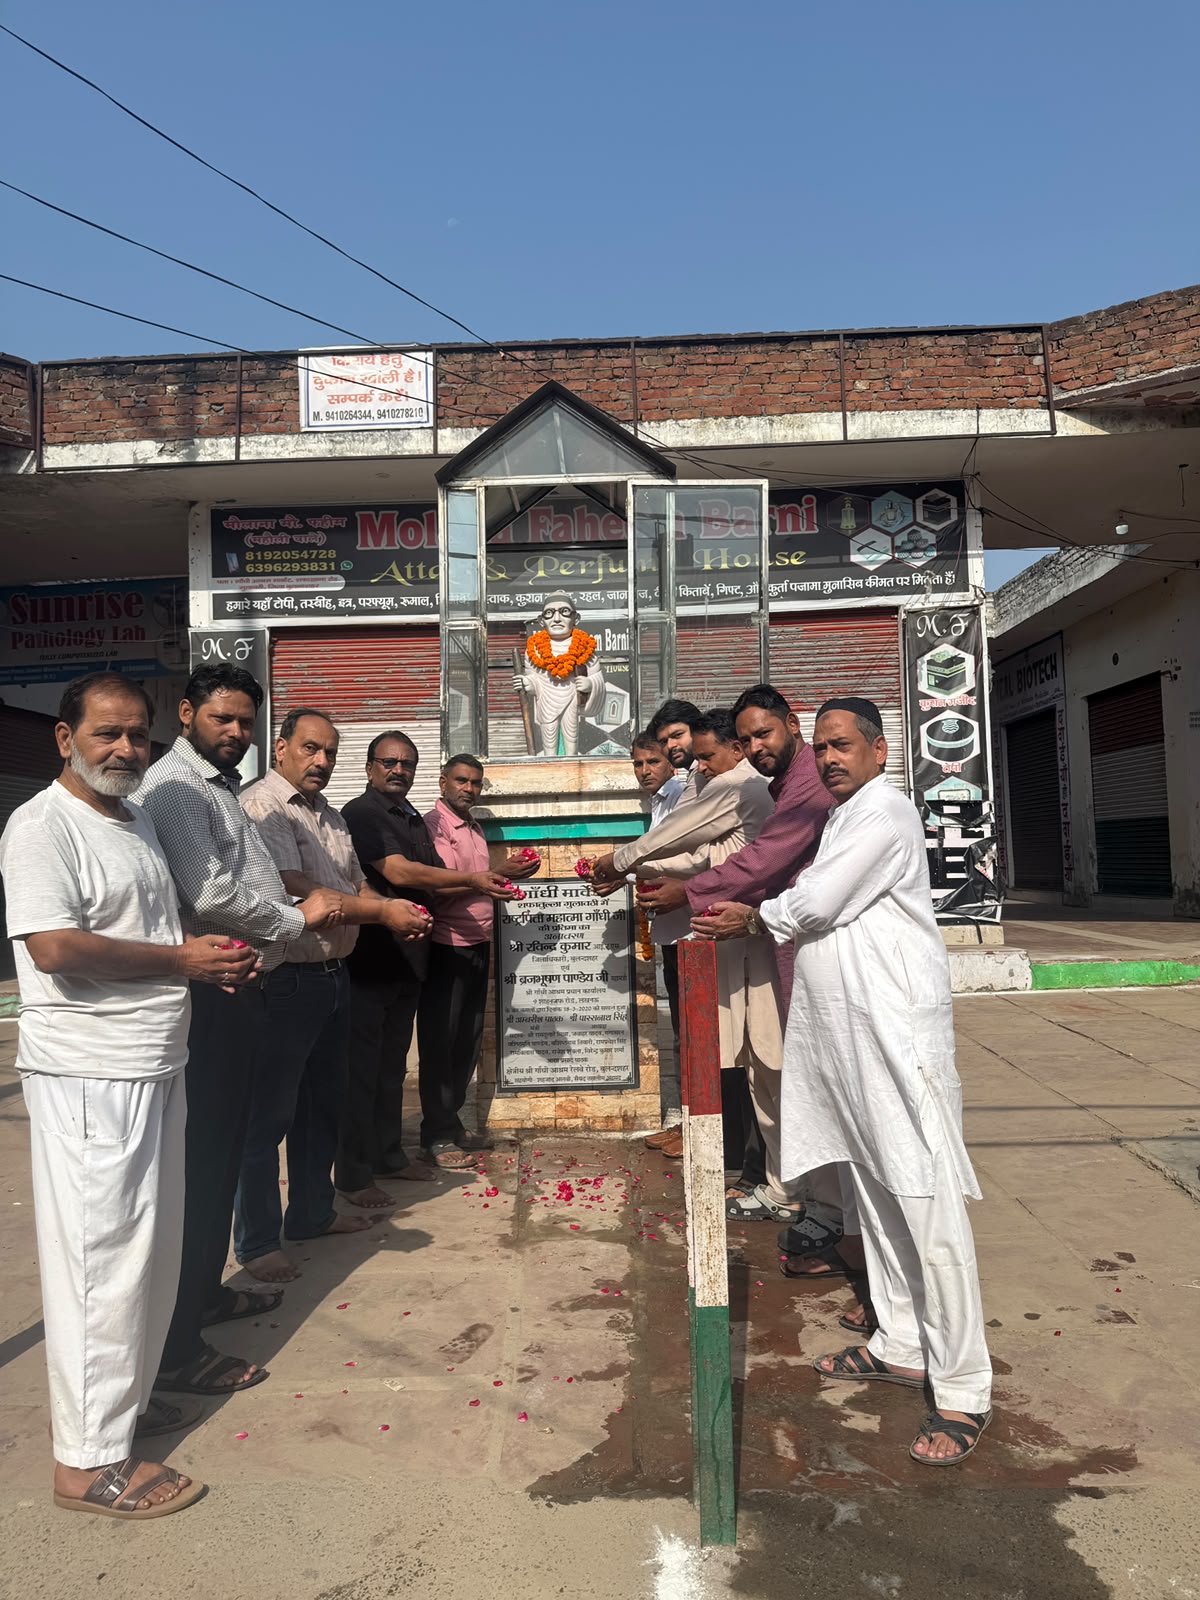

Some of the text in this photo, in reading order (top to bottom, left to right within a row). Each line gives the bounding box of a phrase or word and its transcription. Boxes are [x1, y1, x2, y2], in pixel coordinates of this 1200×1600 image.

[327, 389, 374, 404] सम्पर्क
[313, 411, 323, 421] M.
[698, 495, 818, 540] Barni
[245, 549, 336, 561] 8192054728
[245, 561, 336, 573] 6396293831
[524, 552, 658, 585] Perfum
[226, 597, 250, 612] हमारे
[252, 596, 271, 611] यहाँ
[273, 597, 298, 611] टोपी,
[358, 598, 397, 611] परफ्यूम,
[400, 596, 433, 609] रूमाल,
[515, 592, 543, 607] कुरान
[579, 591, 605, 604] रहल,
[679, 582, 714, 599] किताबें,
[767, 579, 790, 597] कुर्ता
[789, 581, 821, 592] पजामा
[823, 576, 863, 594] मुनासिब
[865, 575, 894, 588] कीमत
[896, 576, 910, 587] पर
[10, 588, 145, 624] Sunrise
[604, 628, 630, 652] Barni
[1016, 652, 1058, 694] BIOTECH
[546, 913, 583, 923] महात्मा
[585, 909, 610, 921] गाँधी
[612, 909, 626, 921] जी
[509, 940, 524, 952] श्री
[525, 940, 557, 952] रविन्द्र
[559, 941, 592, 954] कुमार
[504, 972, 516, 984] श्री
[562, 970, 593, 983] पाण्डेय
[595, 970, 608, 982] जी
